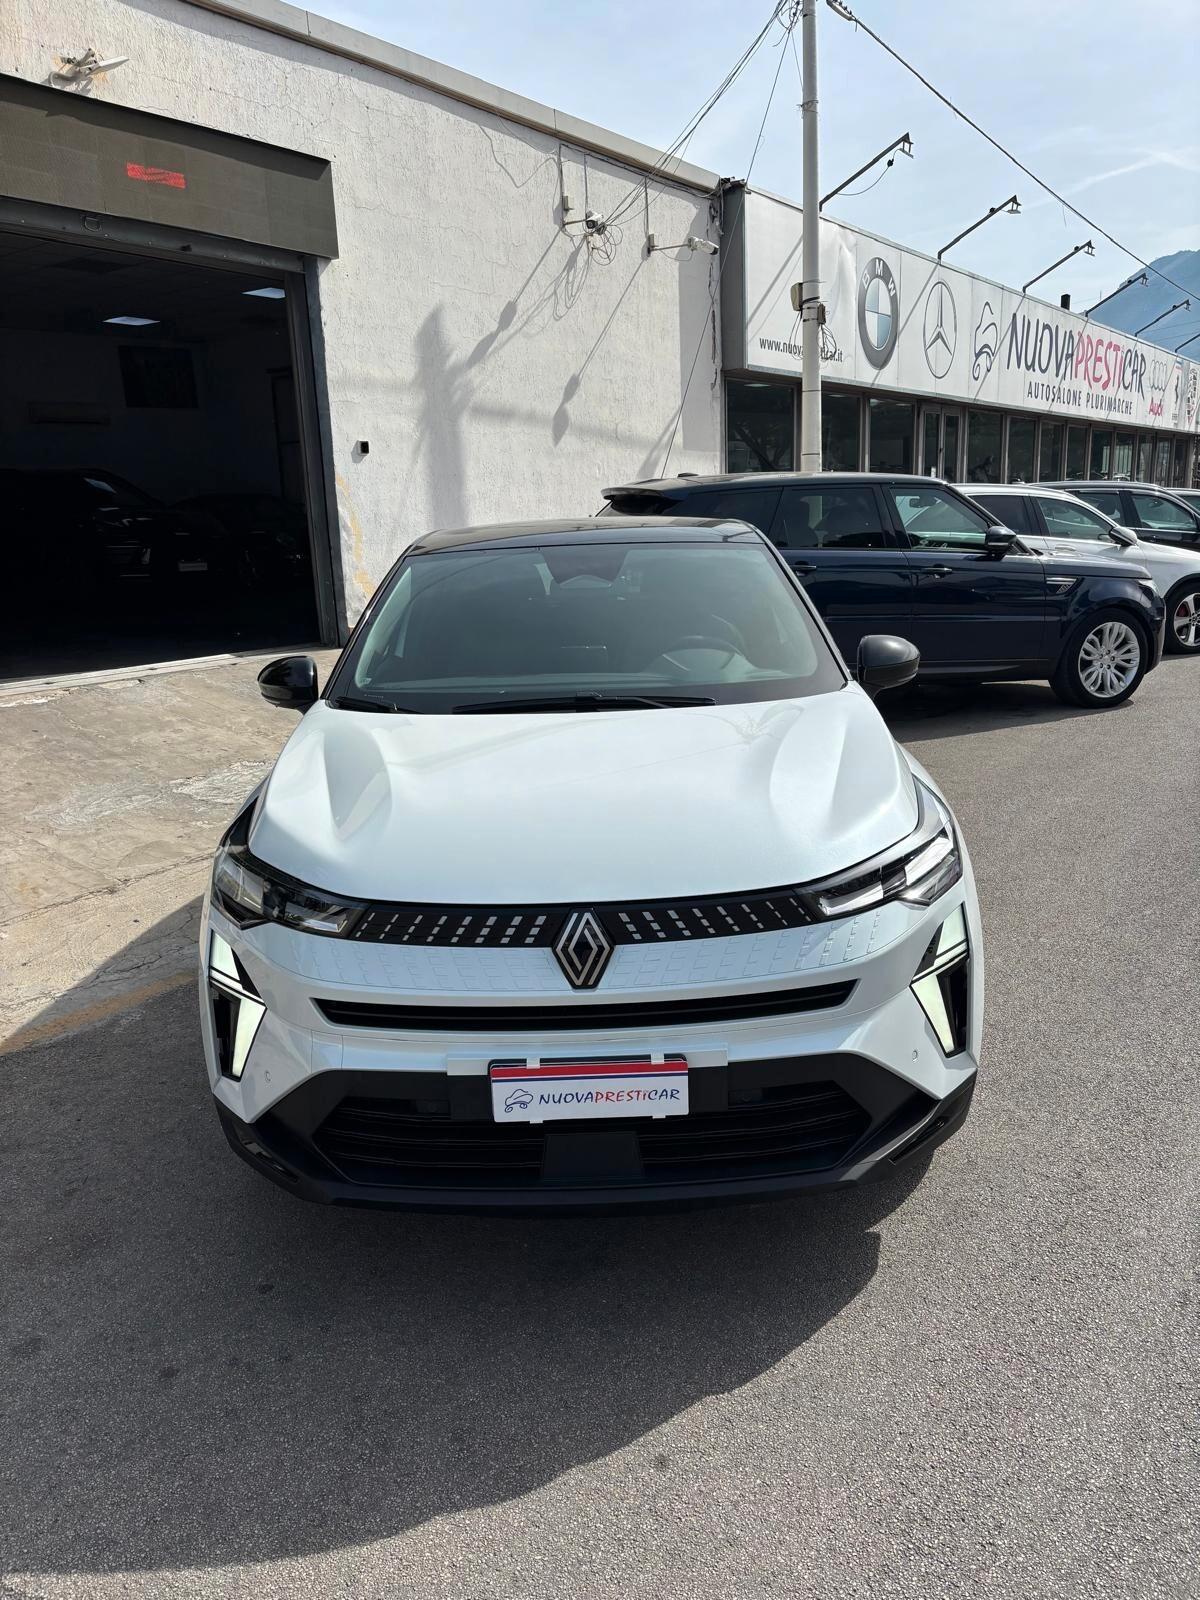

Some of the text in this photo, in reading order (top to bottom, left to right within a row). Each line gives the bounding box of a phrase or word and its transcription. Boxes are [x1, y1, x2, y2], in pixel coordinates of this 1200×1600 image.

[862, 258, 896, 297] BMW
[1027, 381, 1133, 415] AUTOSALONE PLURIMARCHE
